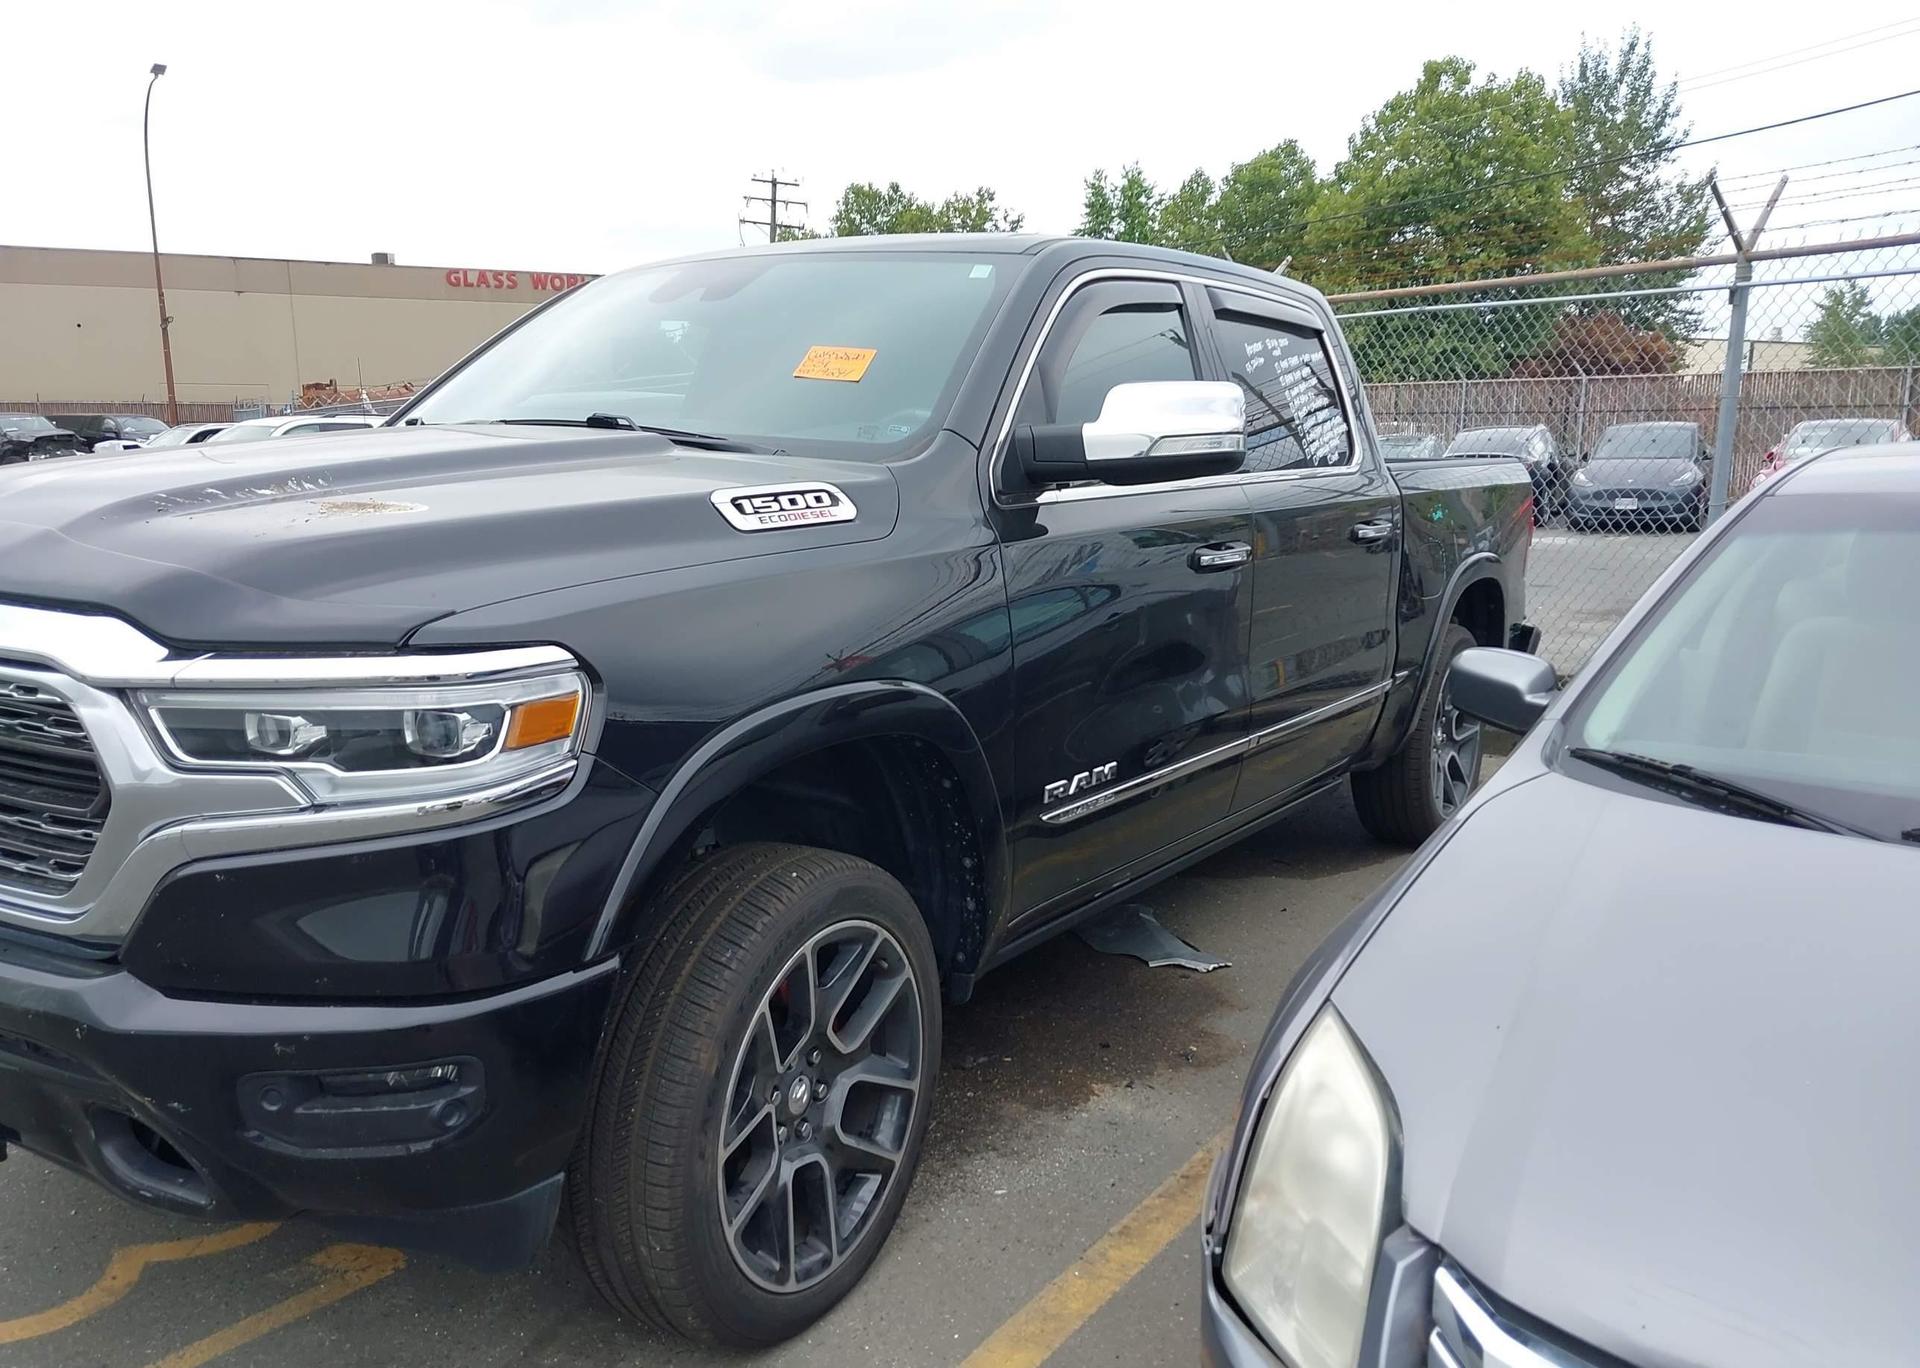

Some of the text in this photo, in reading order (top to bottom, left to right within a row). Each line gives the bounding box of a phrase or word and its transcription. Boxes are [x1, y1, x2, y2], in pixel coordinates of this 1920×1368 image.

[446, 269, 585, 291] GLASS WOR
[734, 491, 832, 514] 1500
[758, 509, 838, 525] ECODIESEL
[1043, 761, 1118, 804] RAM
